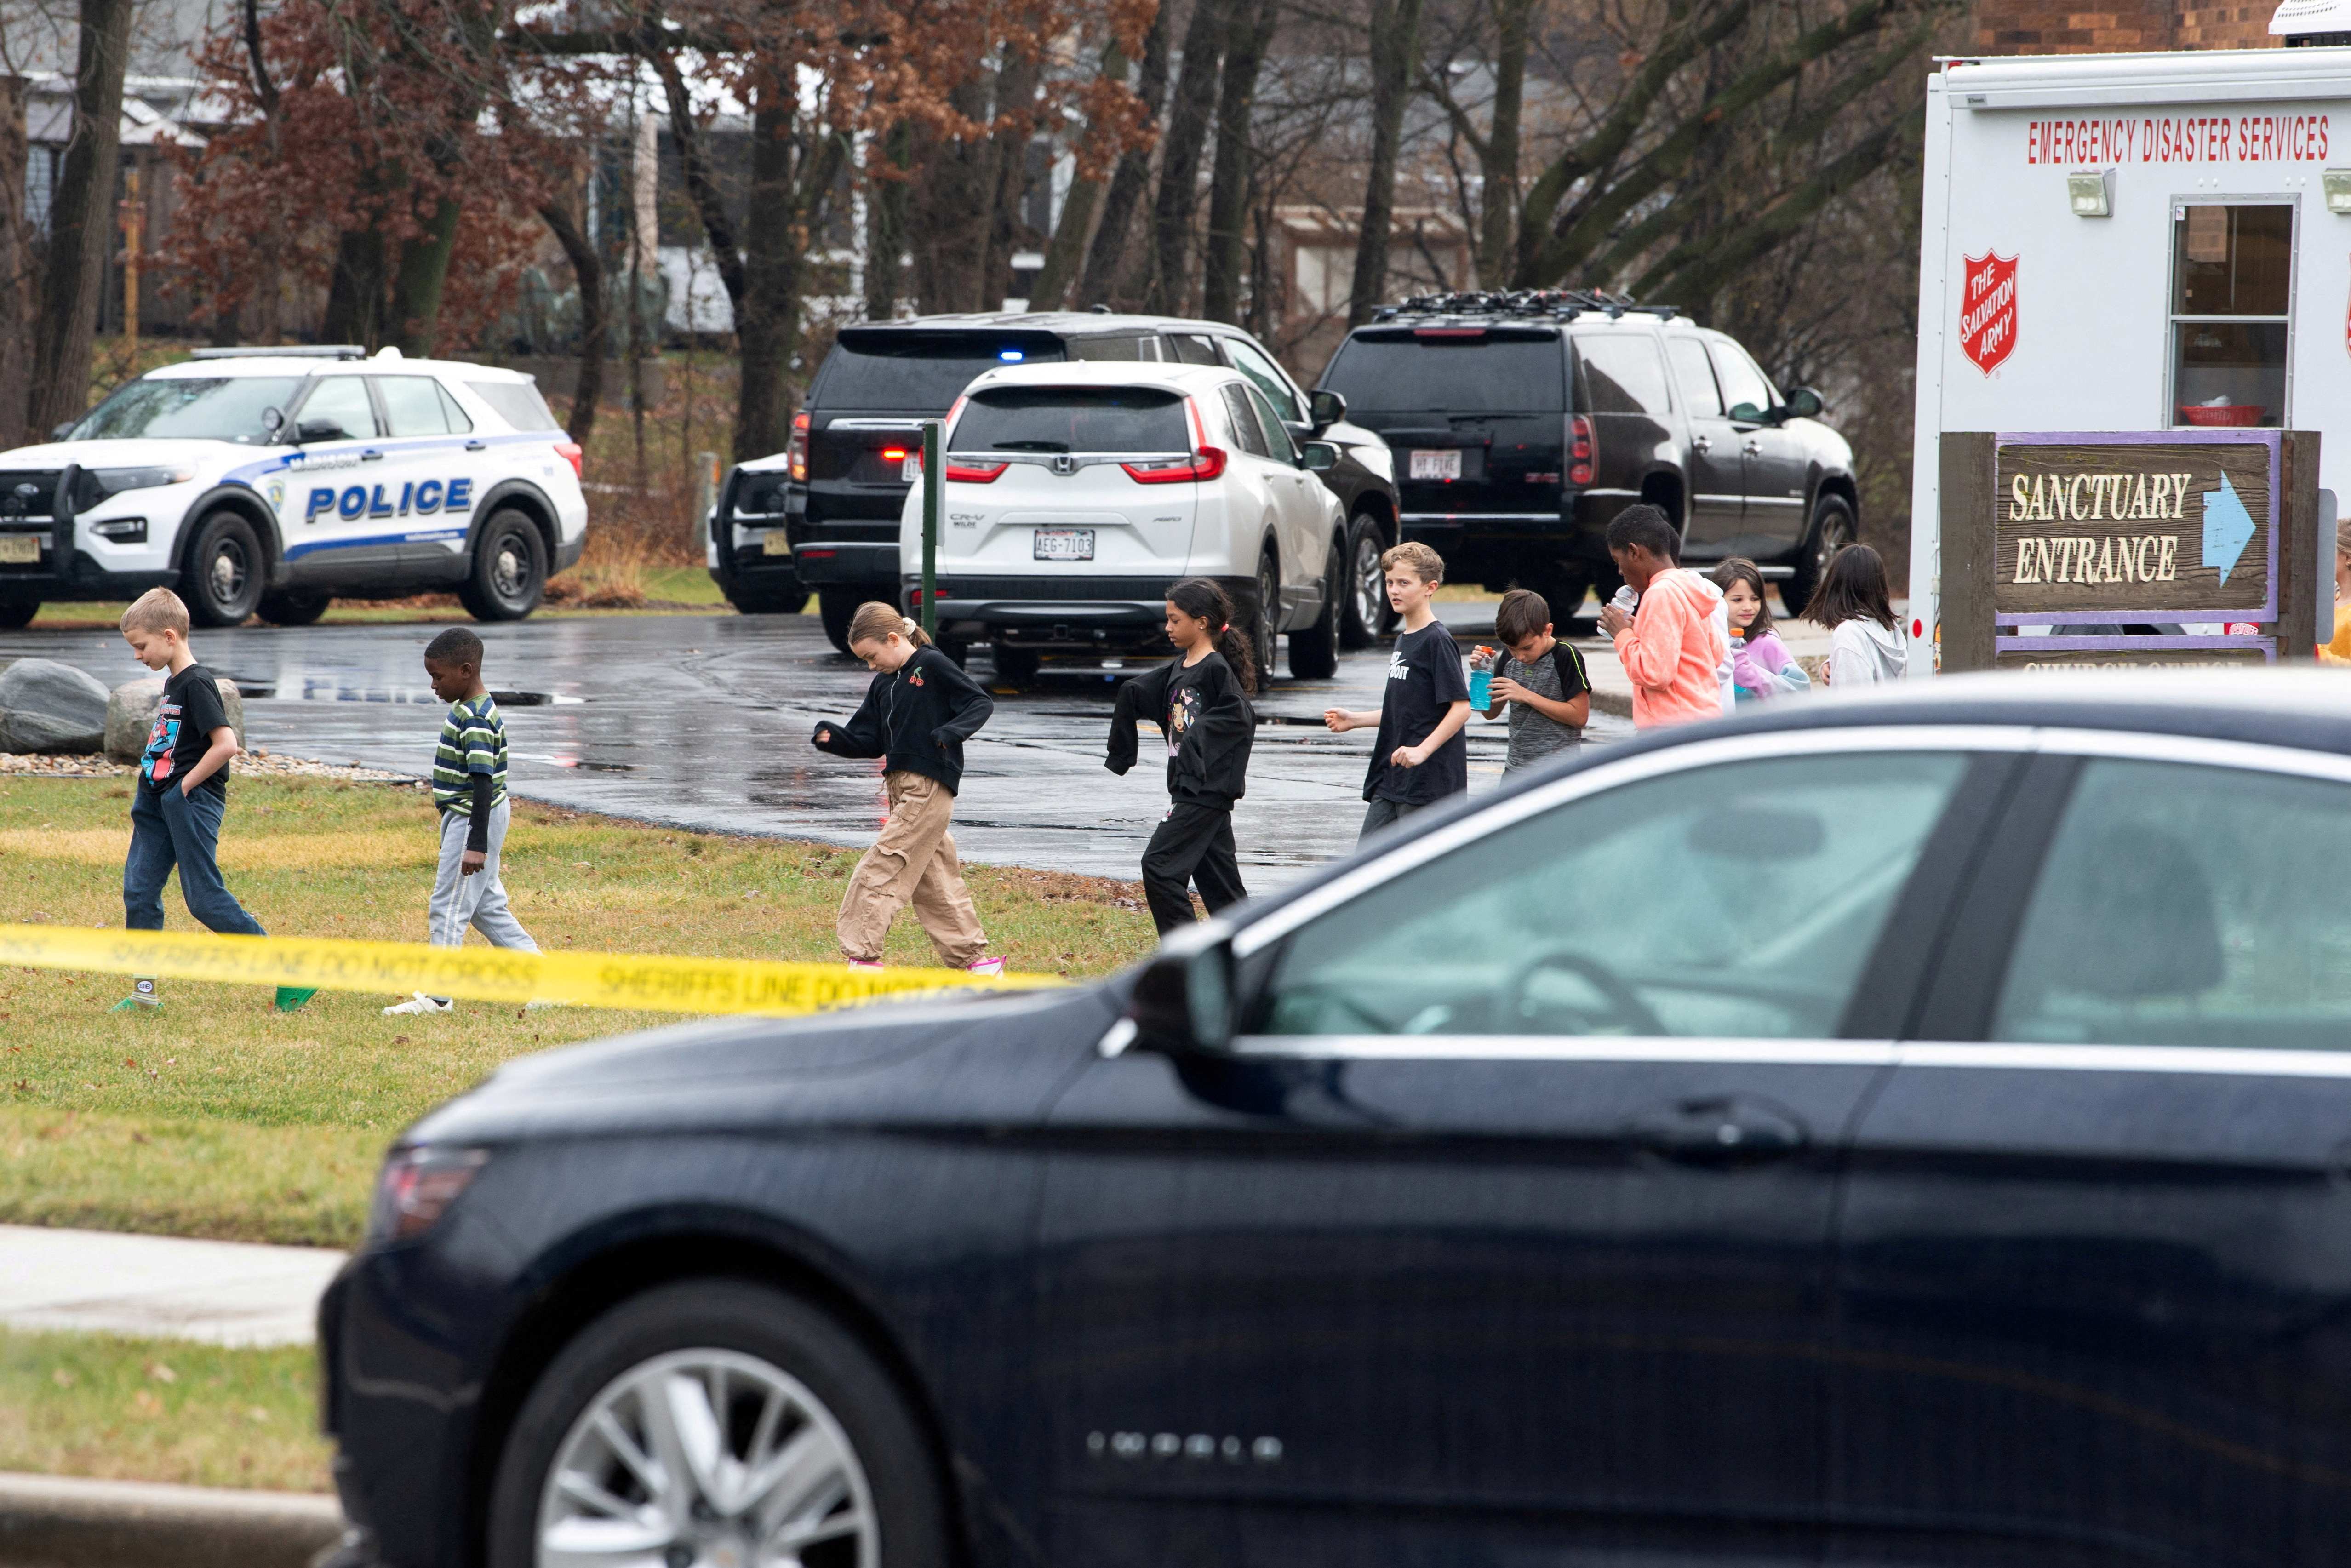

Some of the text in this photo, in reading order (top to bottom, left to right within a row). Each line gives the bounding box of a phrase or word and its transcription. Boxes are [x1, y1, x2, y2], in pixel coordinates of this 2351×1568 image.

[2028, 115, 2328, 164] EMERGENCY DISASTER SERVICES
[1971, 262, 1995, 300] THE
[1962, 270, 2014, 343] SALVATION
[1979, 307, 2013, 361] ARMY
[1434, 458, 1455, 471] FIVE
[305, 478, 472, 523] POLICE
[2009, 473, 2192, 521] SANCTUARY
[1037, 538, 1092, 553] AEG-7103
[2013, 535, 2178, 584] ENTRANCE
